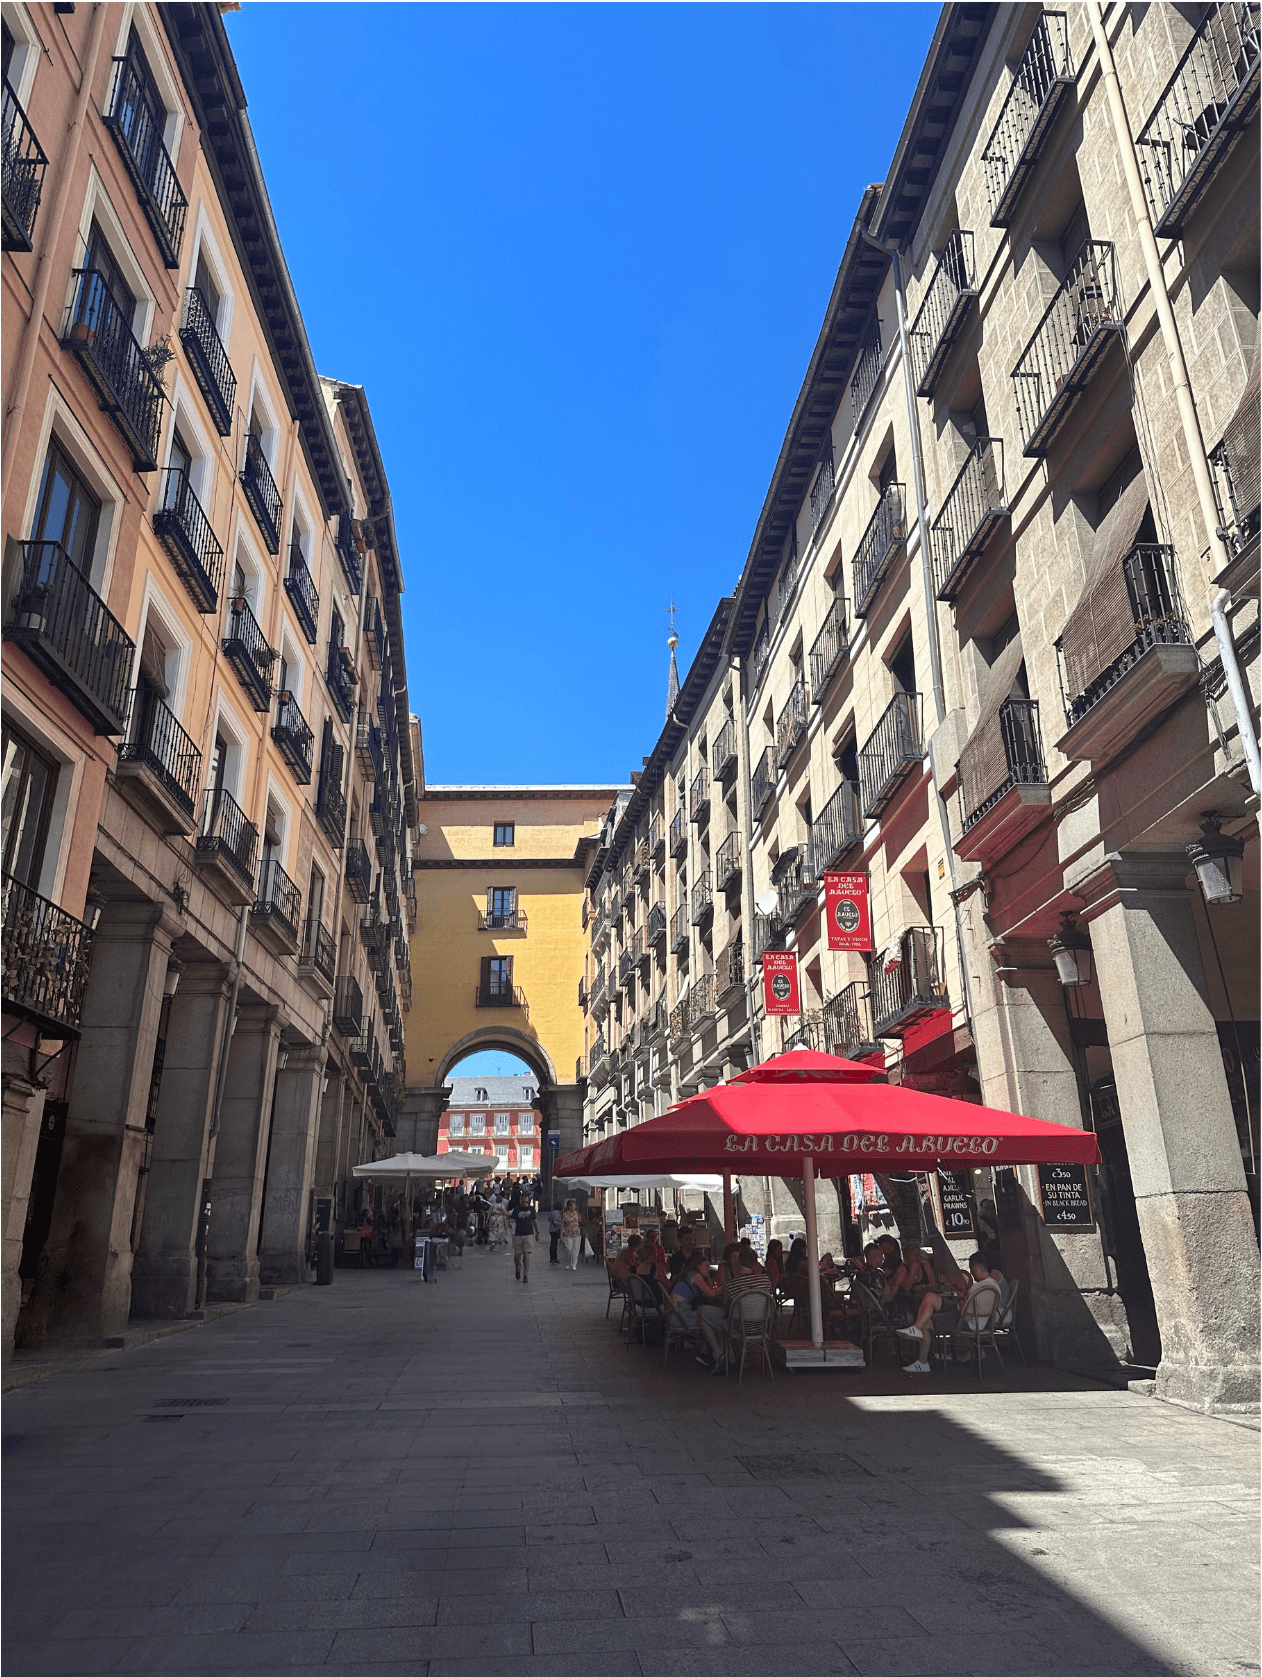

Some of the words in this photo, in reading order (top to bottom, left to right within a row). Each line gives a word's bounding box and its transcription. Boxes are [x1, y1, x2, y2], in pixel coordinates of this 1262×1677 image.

[724, 1134, 759, 1152] LA
[765, 1134, 835, 1152] CASA
[840, 1134, 890, 1153] DEL
[896, 1135, 999, 1154] ABUELO
[1045, 1183, 1056, 1191] EN
[1057, 1183, 1072, 1191] PAN
[1072, 1183, 1082, 1191] DE
[943, 1194, 965, 1202] GARLIC
[1047, 1191, 1057, 1199] SU
[1058, 1191, 1081, 1199] TINTA
[943, 1202, 968, 1210] PRAWNS
